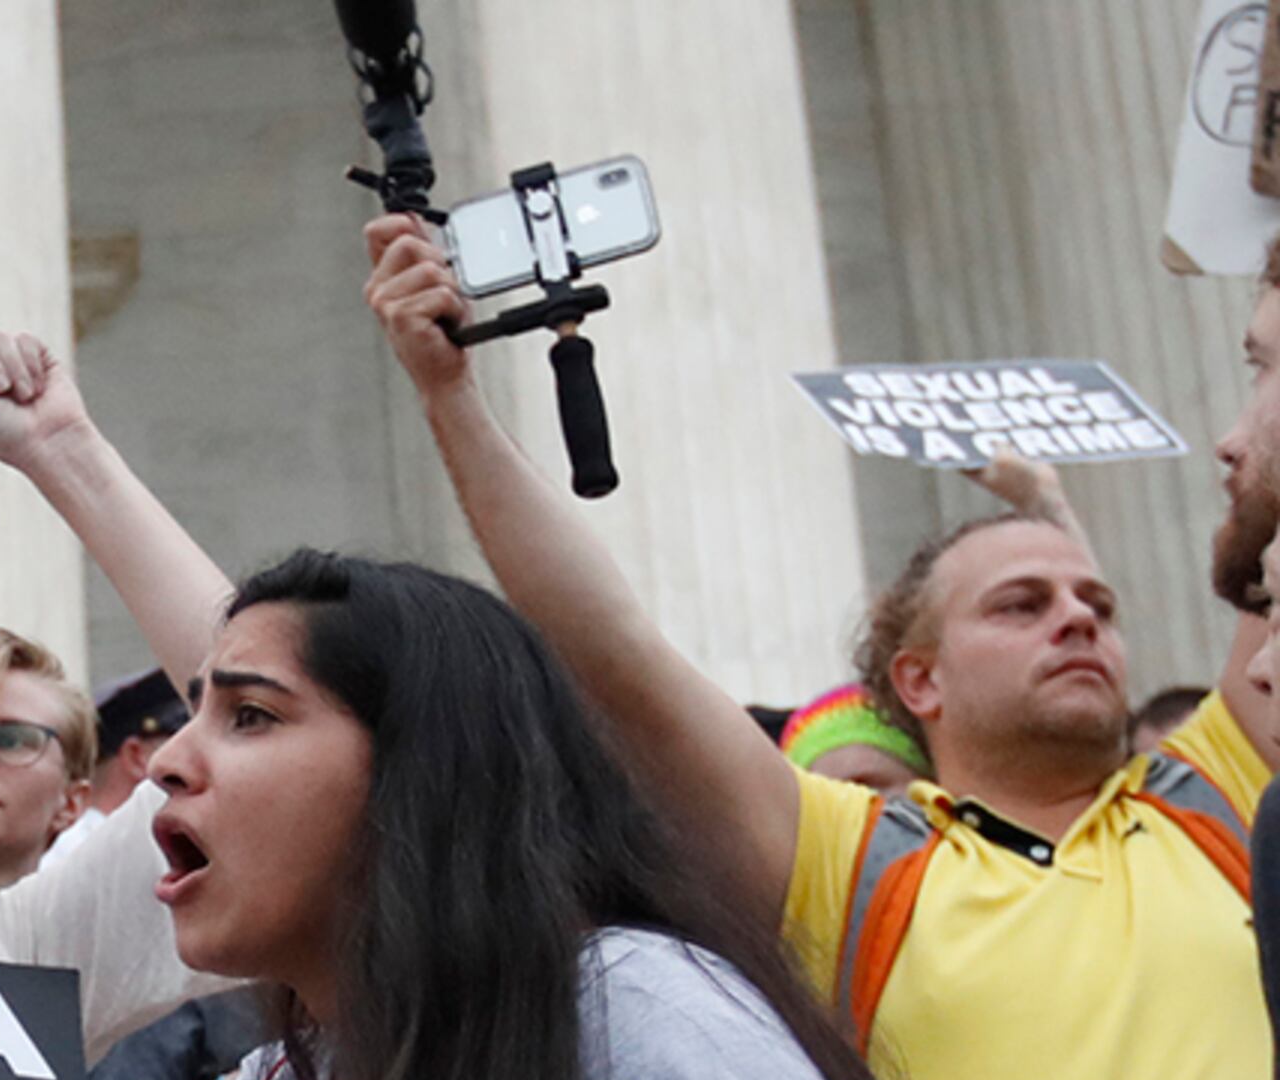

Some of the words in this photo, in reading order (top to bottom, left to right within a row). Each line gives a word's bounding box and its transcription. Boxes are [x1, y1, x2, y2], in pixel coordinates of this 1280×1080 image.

[843, 368, 1076, 400] SEXUAL
[829, 392, 1134, 432] VIOLENCE
[844, 422, 908, 458] IS
[921, 429, 968, 462] A
[972, 418, 1171, 457] CRIME
